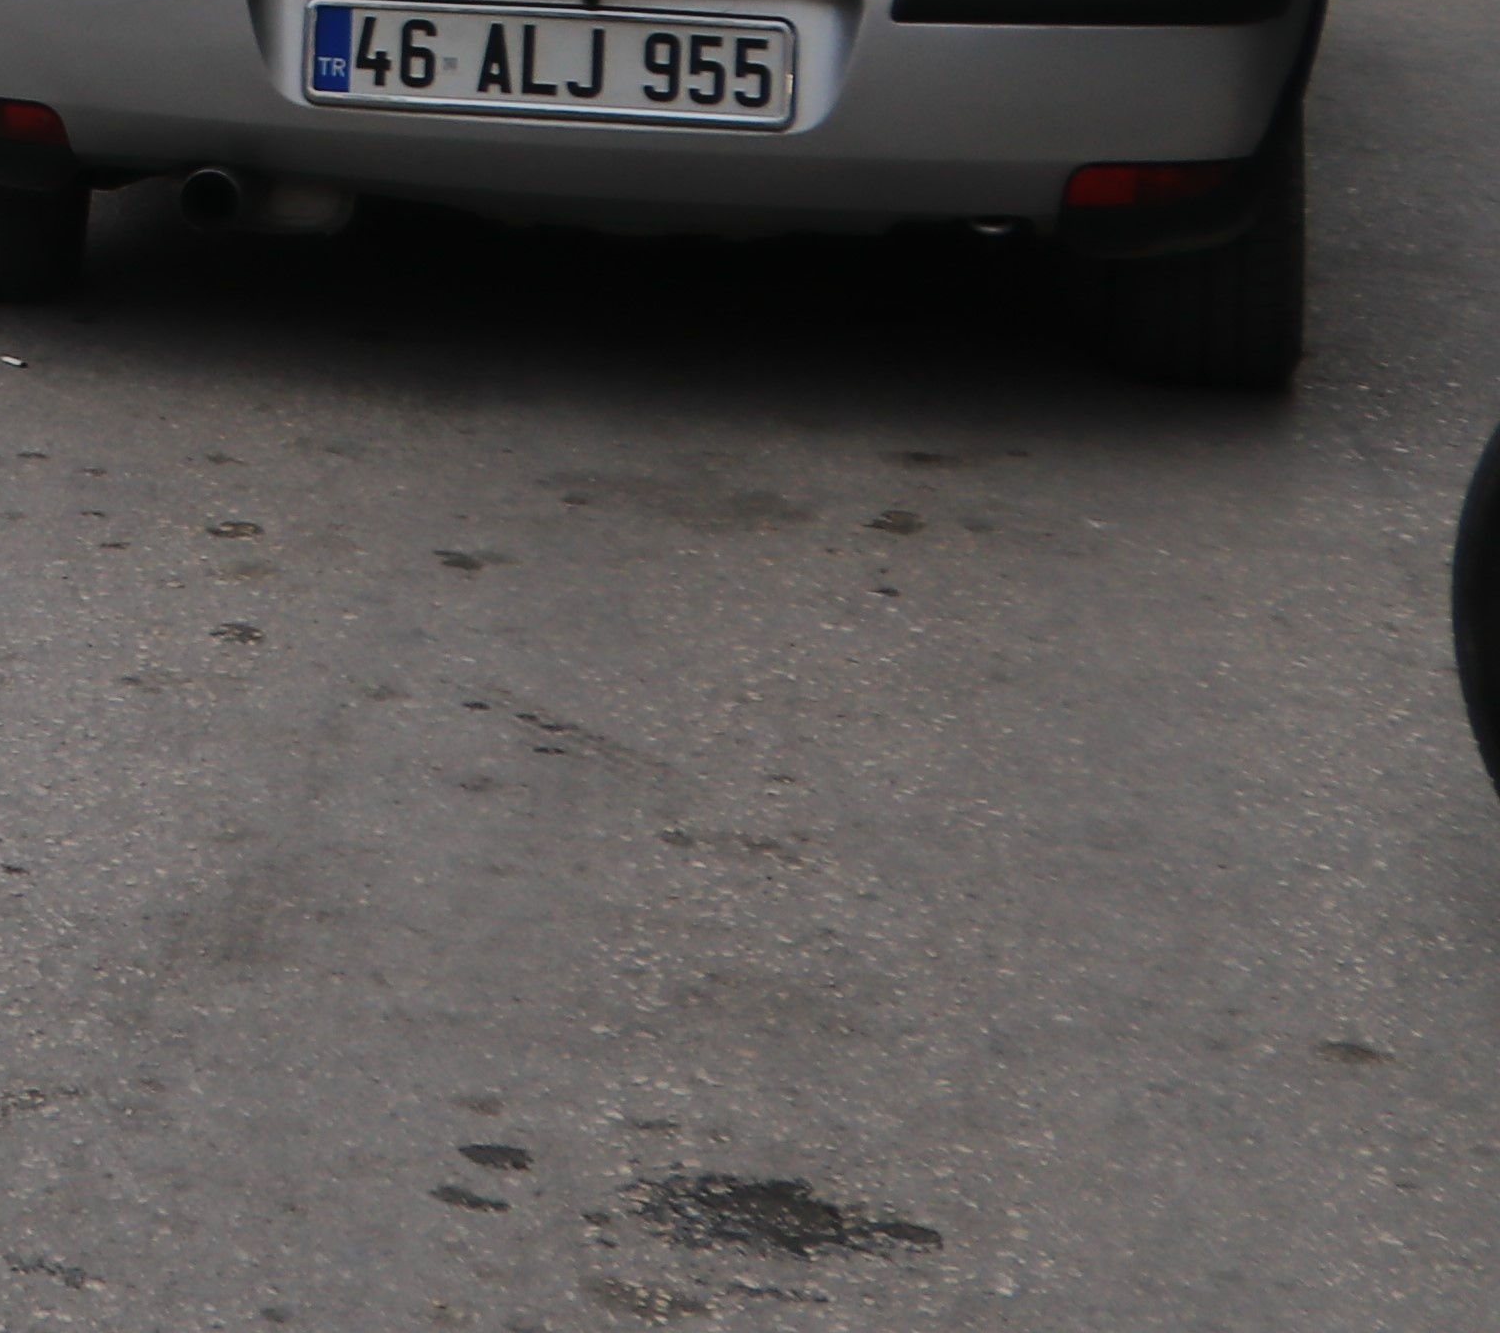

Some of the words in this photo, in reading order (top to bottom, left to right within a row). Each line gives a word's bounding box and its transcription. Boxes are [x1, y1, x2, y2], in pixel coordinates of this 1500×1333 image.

[318, 55, 346, 77] TR
[355, 16, 437, 90] 46
[477, 22, 606, 99] ALJ
[643, 32, 772, 109] 955
